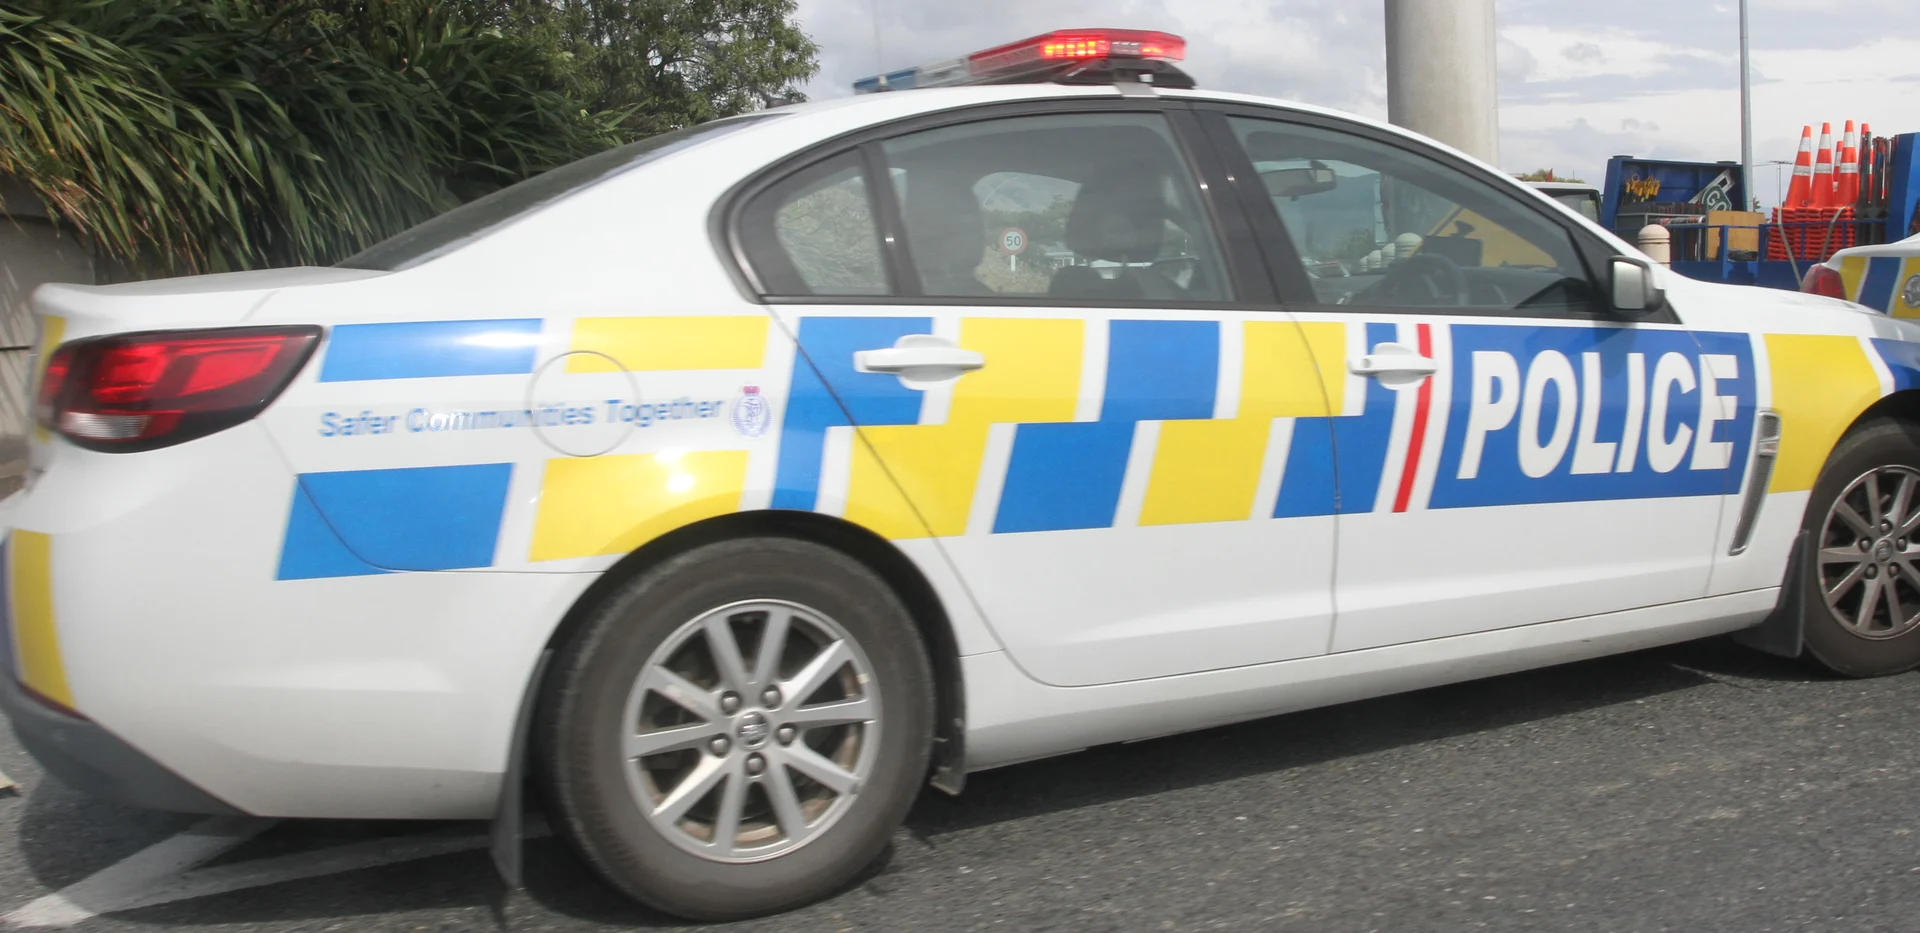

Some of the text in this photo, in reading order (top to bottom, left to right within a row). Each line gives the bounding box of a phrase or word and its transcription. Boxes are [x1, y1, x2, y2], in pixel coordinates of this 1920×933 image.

[1006, 236, 1023, 246] 50
[318, 396, 724, 437] Safer Communities Together
[1456, 349, 1738, 479] POLICE
